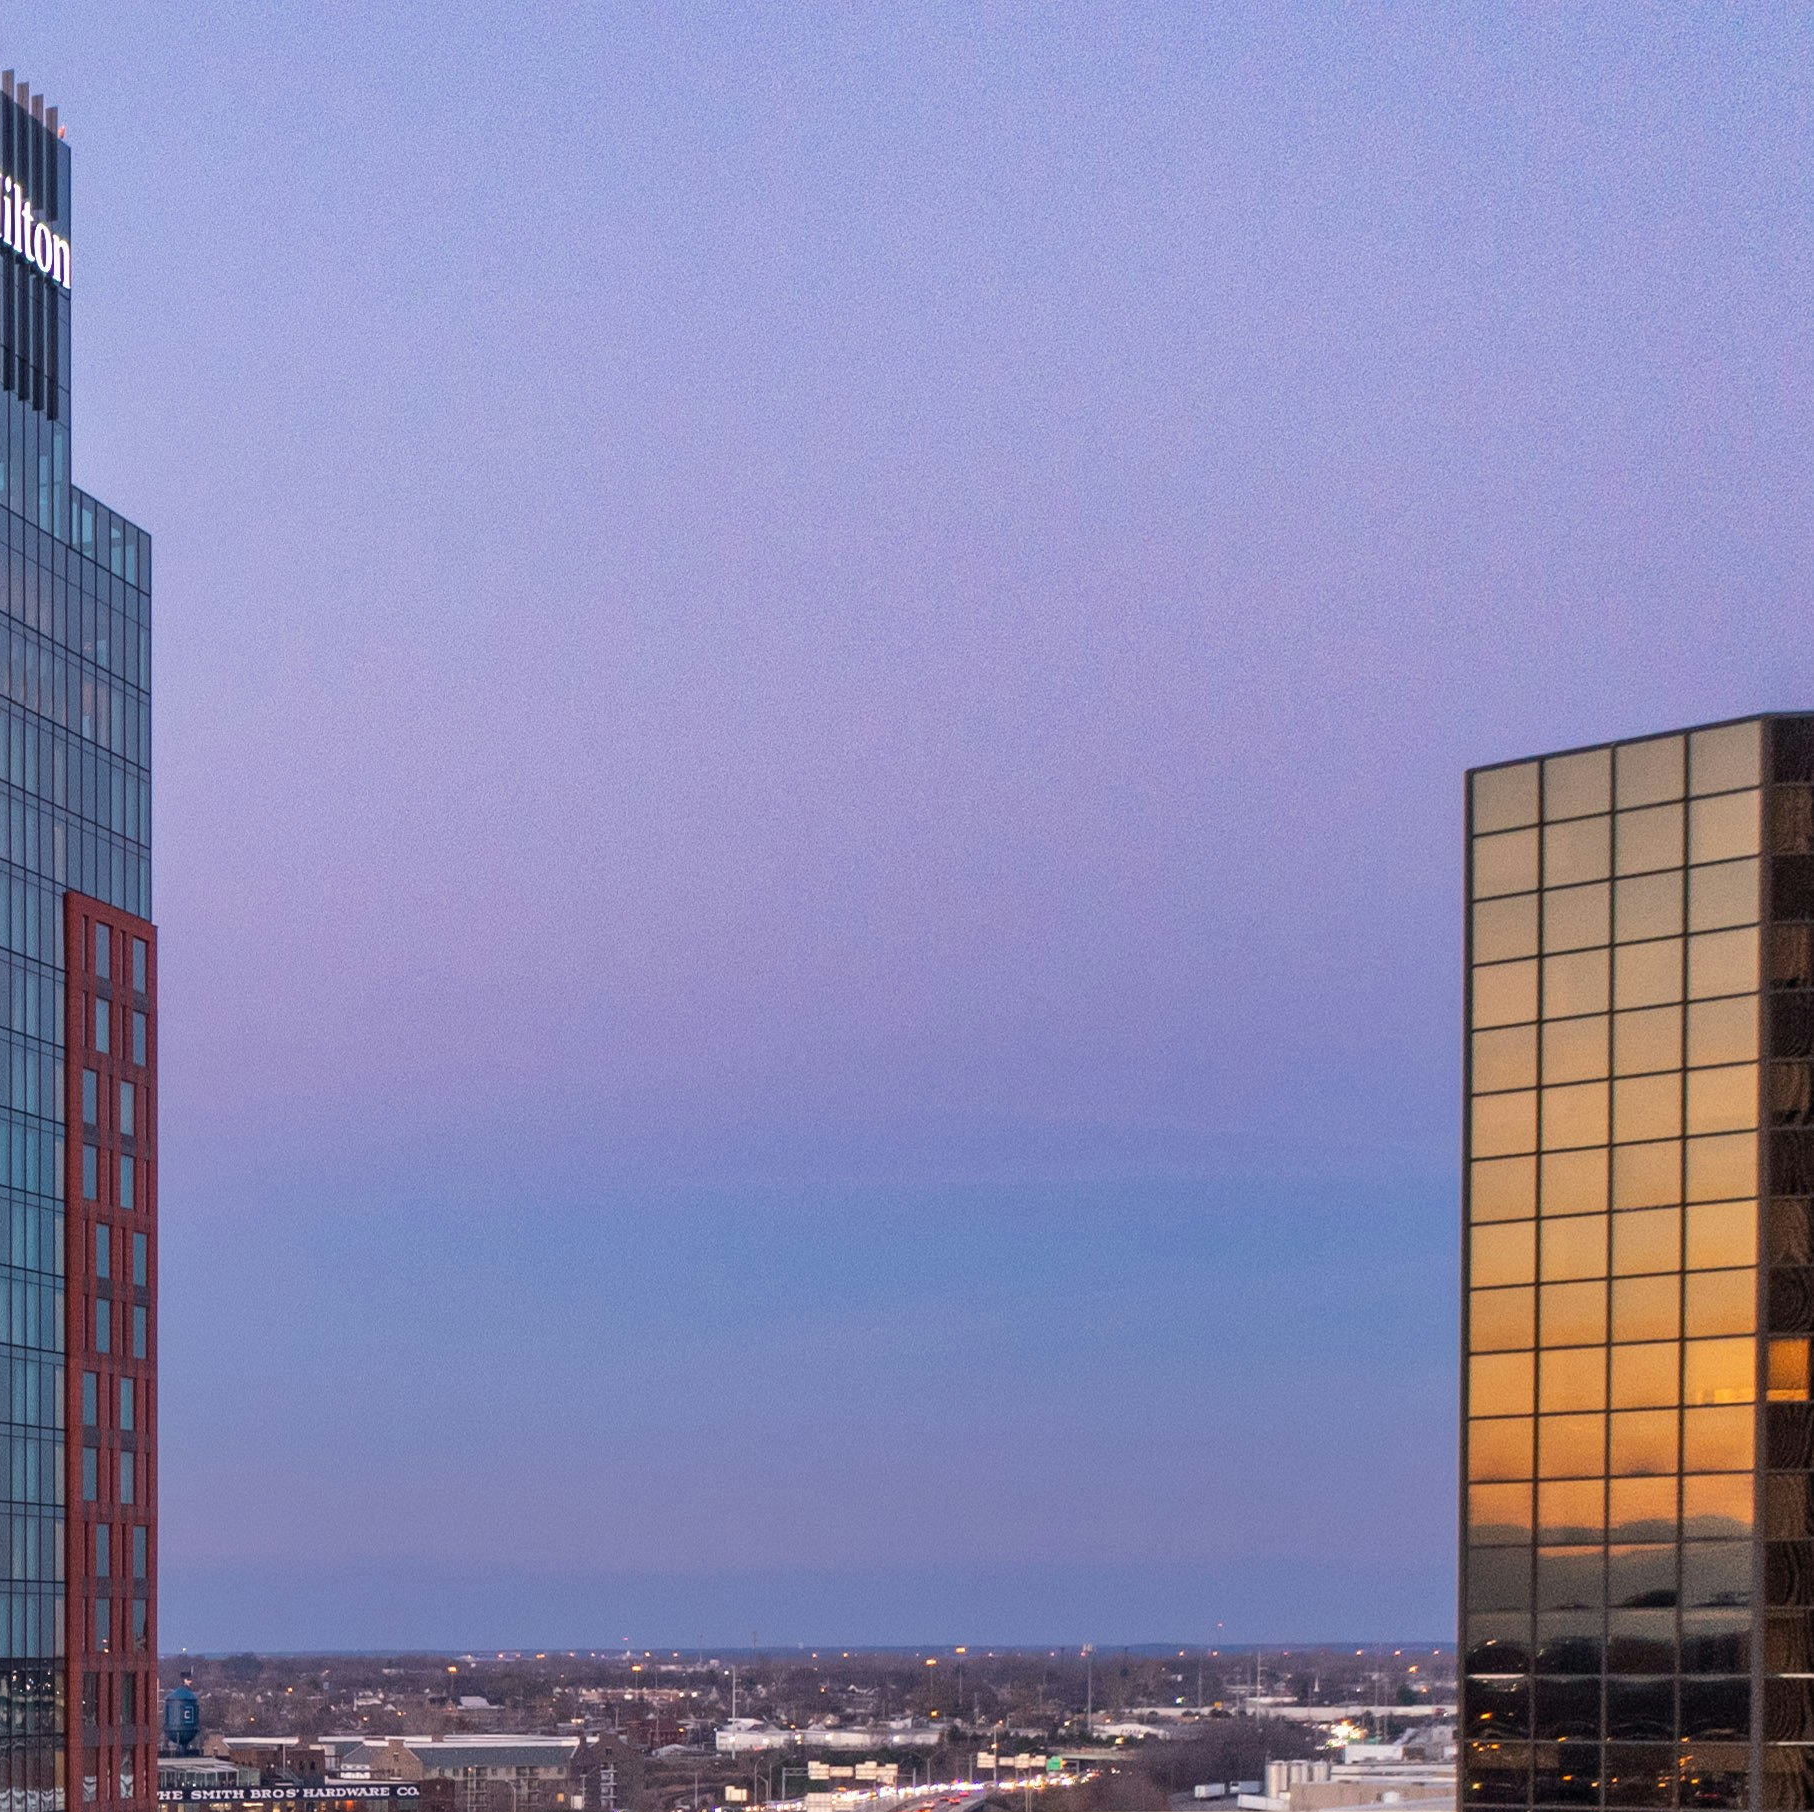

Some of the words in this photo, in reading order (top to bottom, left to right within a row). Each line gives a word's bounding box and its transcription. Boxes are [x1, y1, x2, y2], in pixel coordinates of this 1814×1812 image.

[191, 1789, 245, 1800] SMITH
[302, 1787, 391, 1798] HARDWARE
[396, 1786, 420, 1797] CO.
